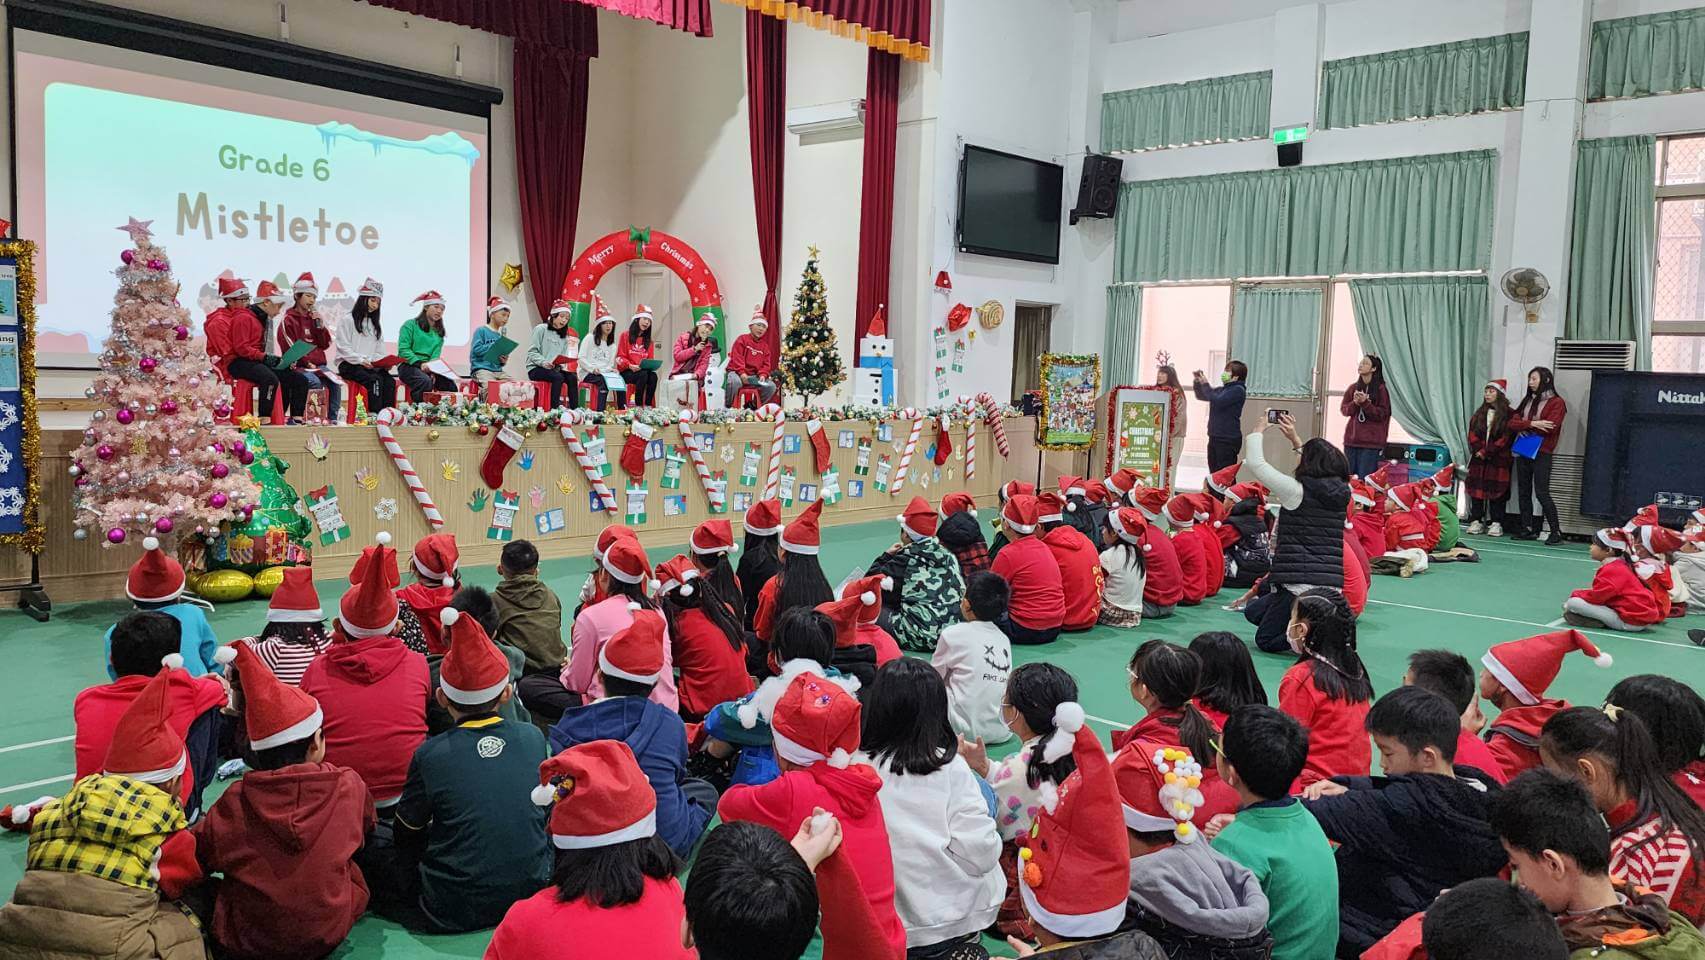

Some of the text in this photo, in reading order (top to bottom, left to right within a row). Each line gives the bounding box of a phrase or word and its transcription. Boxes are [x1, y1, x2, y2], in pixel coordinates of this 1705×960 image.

[219, 144, 330, 182] Grade 6
[176, 191, 380, 250] Mistletoe
[587, 241, 694, 270] Merry Christmas
